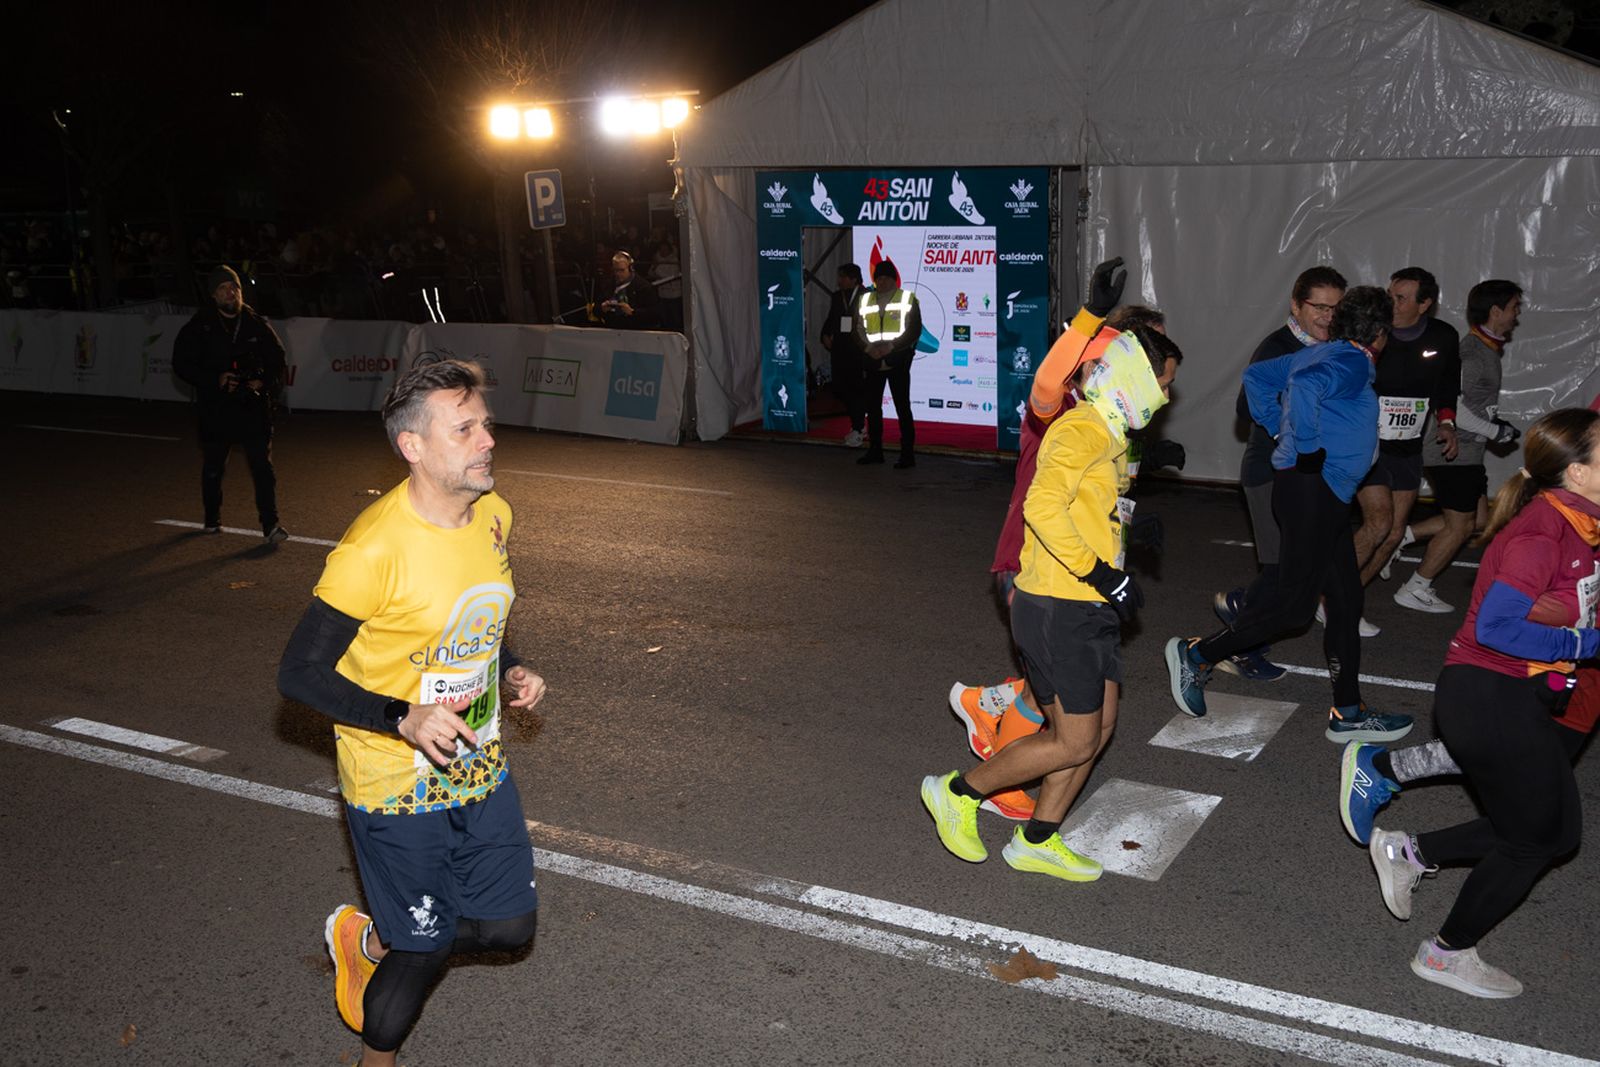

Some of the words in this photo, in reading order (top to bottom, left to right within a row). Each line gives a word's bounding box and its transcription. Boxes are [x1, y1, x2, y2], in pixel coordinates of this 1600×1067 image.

[863, 177, 889, 201] 43
[889, 177, 933, 198] SAN
[534, 177, 556, 222] P
[820, 201, 832, 217] 43
[857, 195, 930, 221] ANTÓN
[959, 200, 973, 217] 43
[926, 241, 950, 249] NOCHE
[949, 241, 959, 249] DE
[760, 249, 798, 258] calderón
[924, 249, 958, 265] SAN
[959, 249, 997, 265] ANT
[999, 252, 1044, 262] calderón
[614, 375, 655, 398] alsa
[1388, 413, 1417, 427] 7186
[447, 680, 477, 694] NOCHE
[434, 695, 456, 705] SAN
